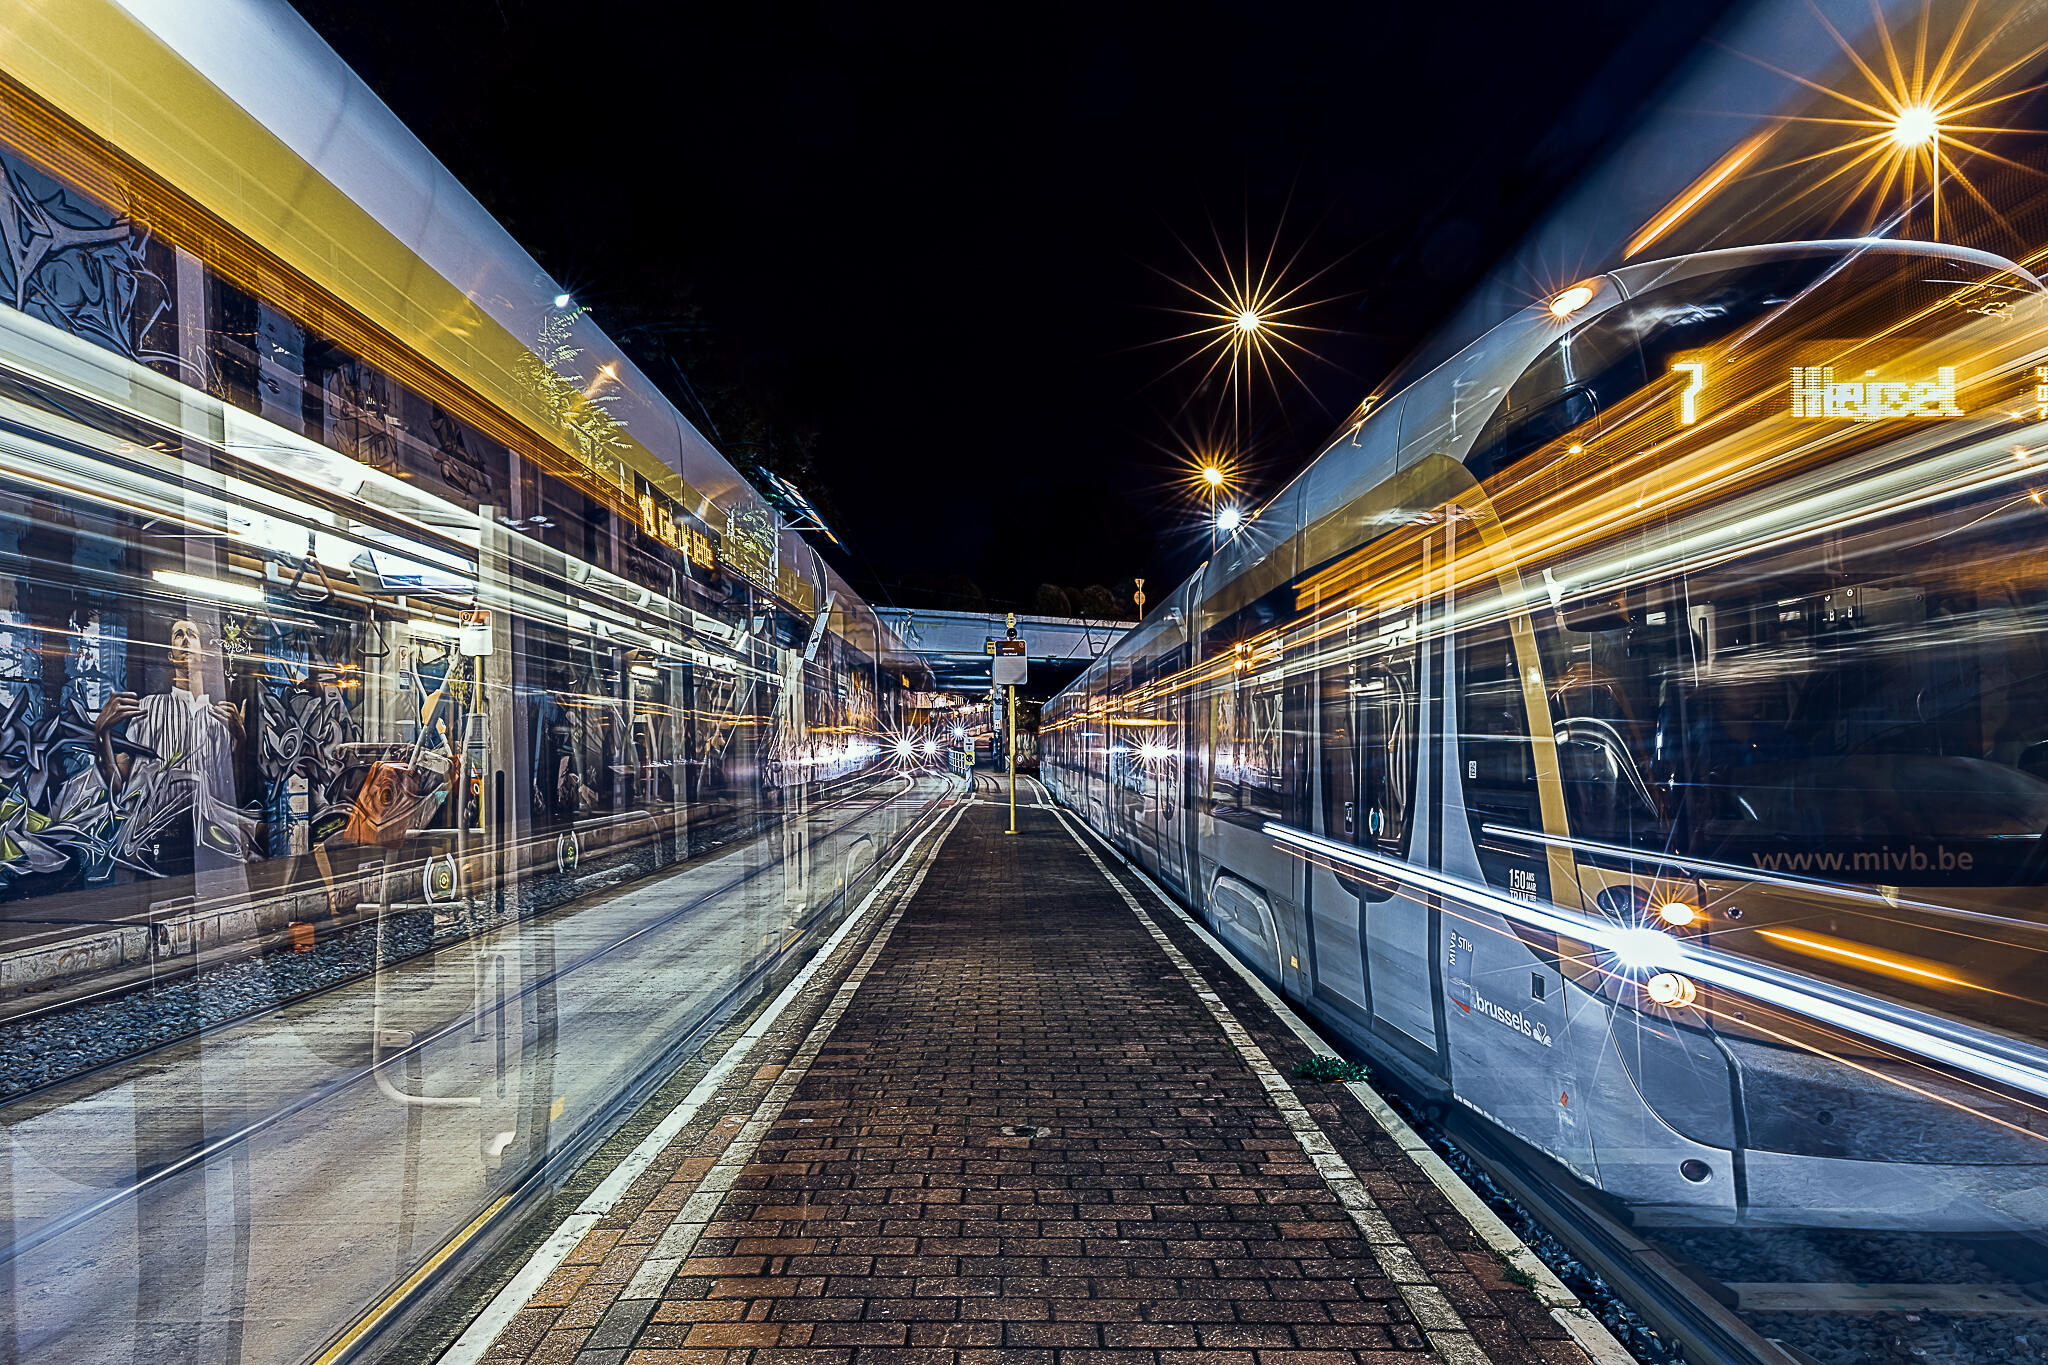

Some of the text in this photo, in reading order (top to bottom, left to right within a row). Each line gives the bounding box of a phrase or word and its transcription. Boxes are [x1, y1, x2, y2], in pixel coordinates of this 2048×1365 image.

[1671, 363, 1704, 424] 7
[1752, 845, 1974, 871] www.mivb.be
[1509, 868, 1526, 890] 150
